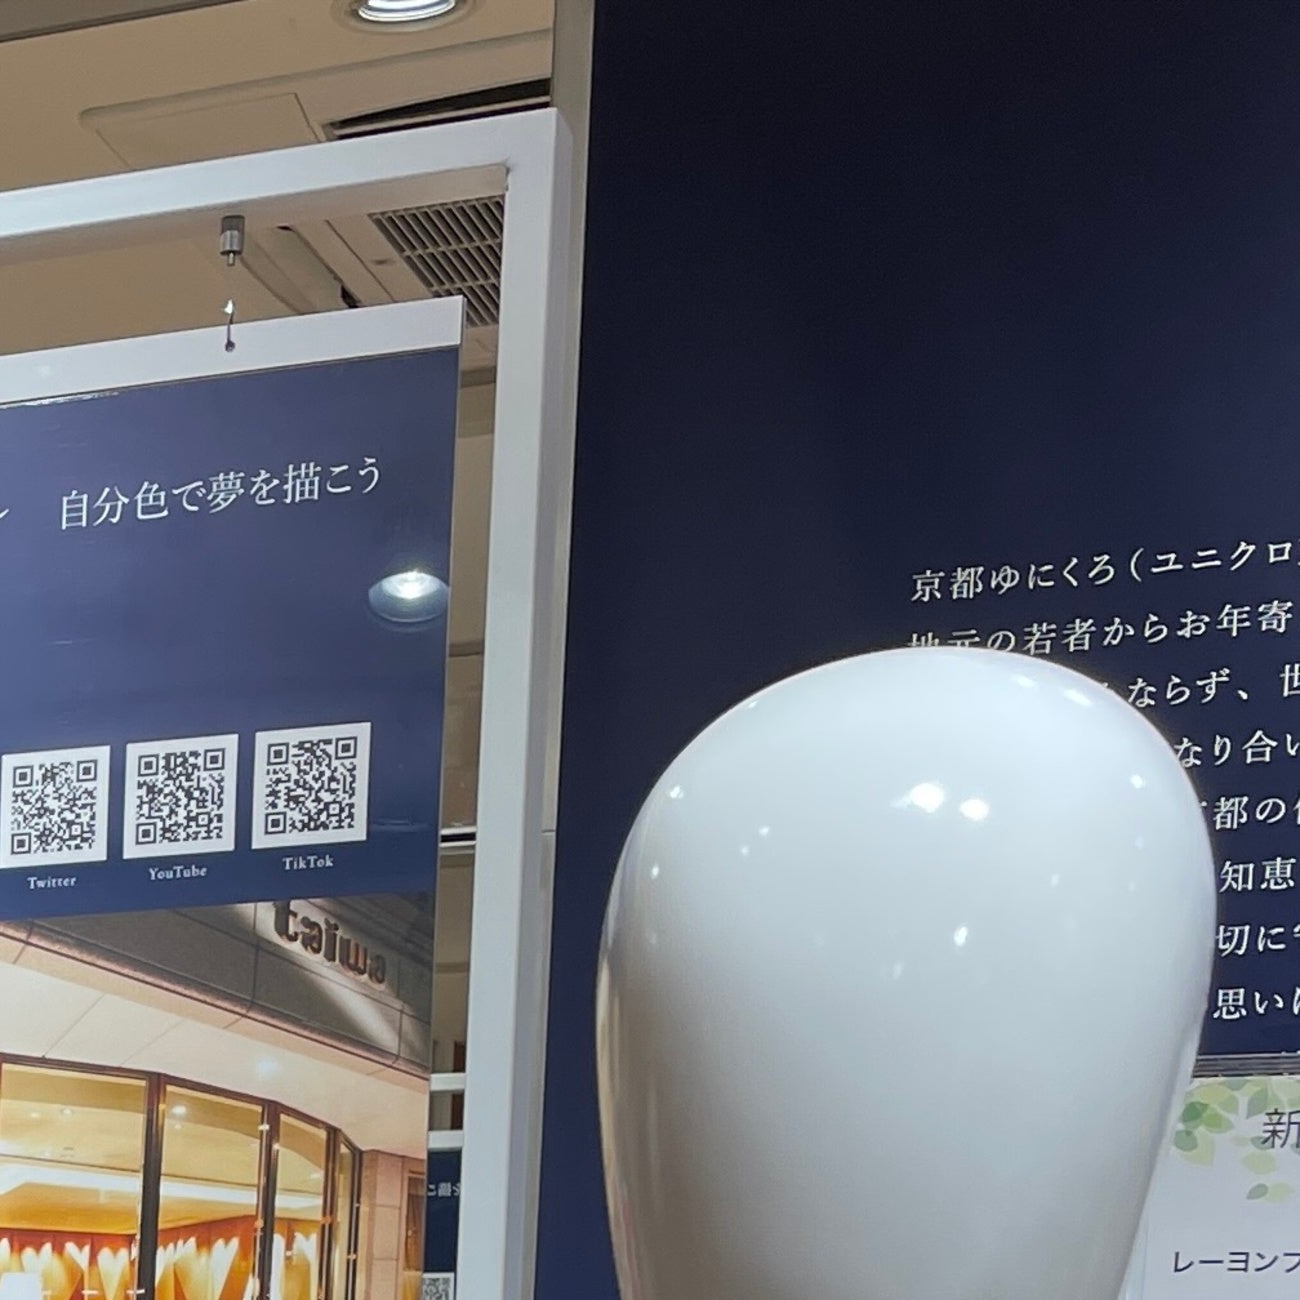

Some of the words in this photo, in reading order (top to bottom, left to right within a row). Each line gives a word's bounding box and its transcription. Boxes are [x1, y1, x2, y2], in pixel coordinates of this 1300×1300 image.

[59, 456, 382, 531] 自分色で夢を描こう
[910, 538, 1300, 602] 京都ゆにくろ（ユニクロ
[1202, 796, 1300, 830] 都の
[147, 863, 208, 882] YouTube
[282, 853, 335, 871] TikTok
[1220, 857, 1296, 893] 知恵
[26, 873, 78, 891] Twitter
